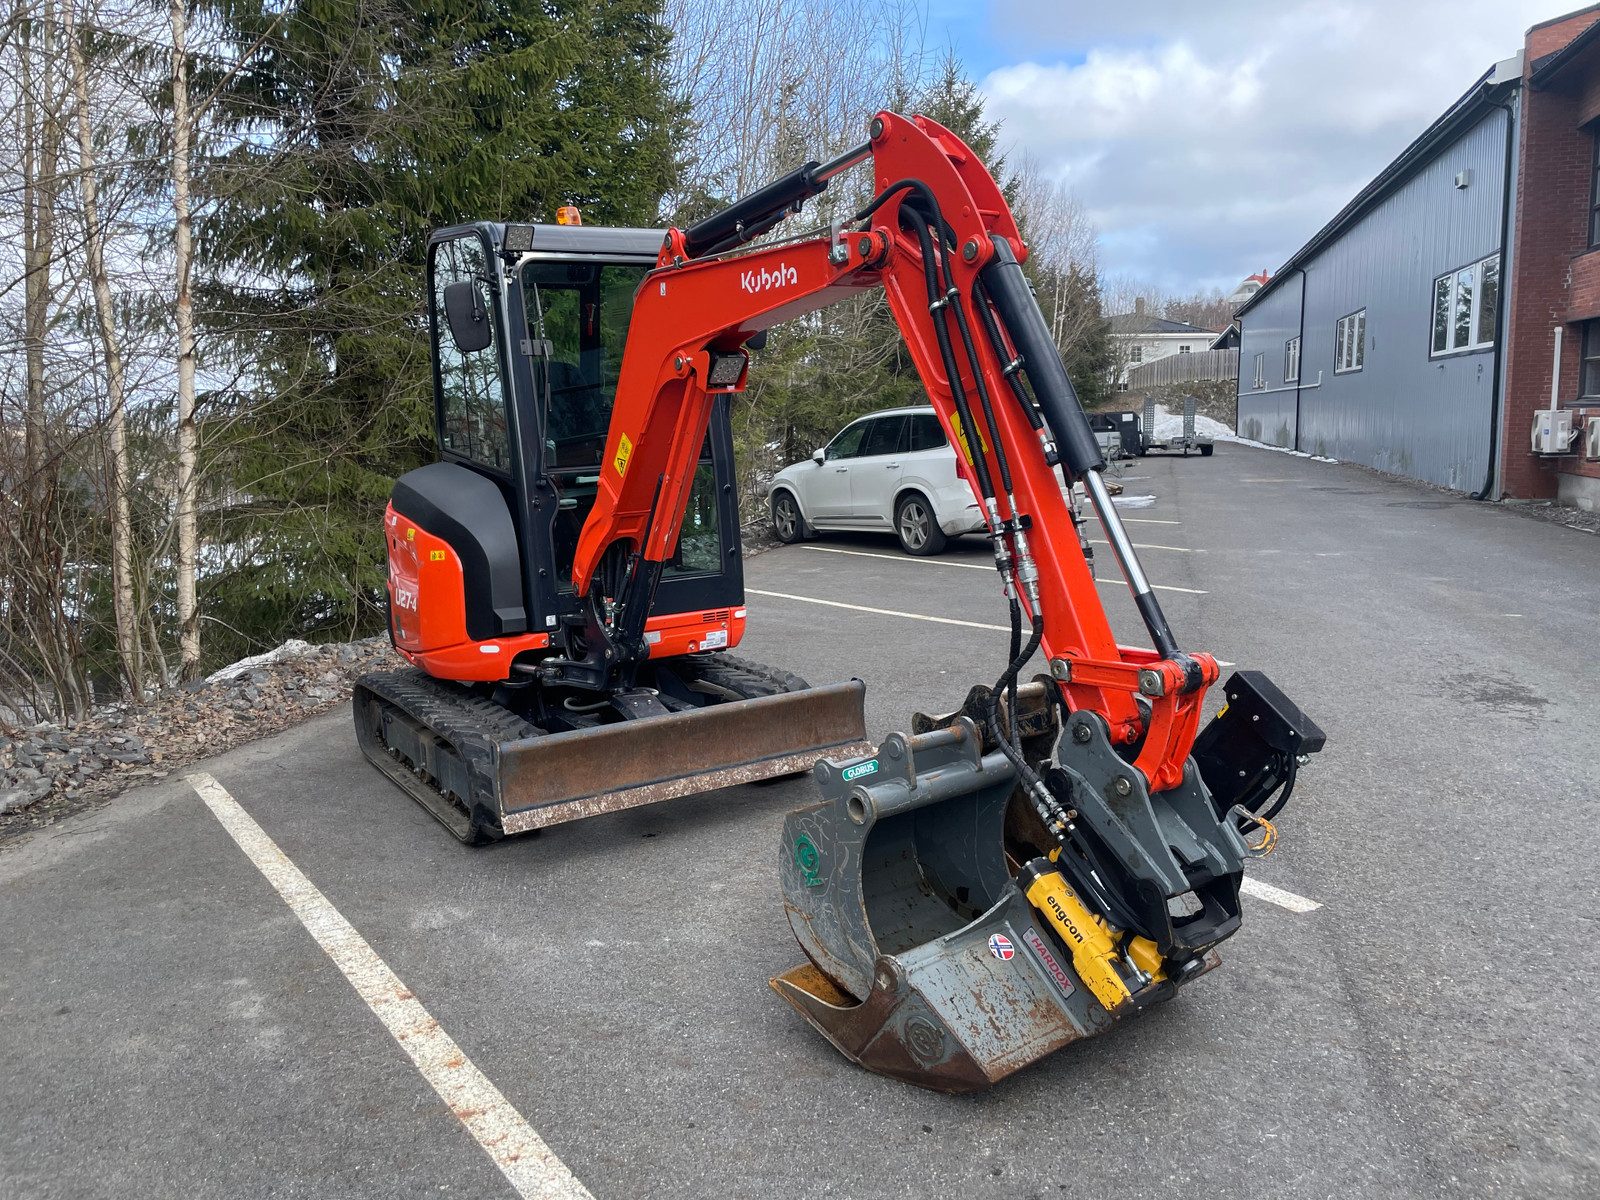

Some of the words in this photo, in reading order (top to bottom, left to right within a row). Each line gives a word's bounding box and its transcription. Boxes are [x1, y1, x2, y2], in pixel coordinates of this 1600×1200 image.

[741, 262, 798, 294] Kubota
[395, 587, 417, 612] U27-4
[847, 762, 875, 778] GLOBUS
[1046, 895, 1084, 944] engcon
[1031, 937, 1072, 990] HARDOX
